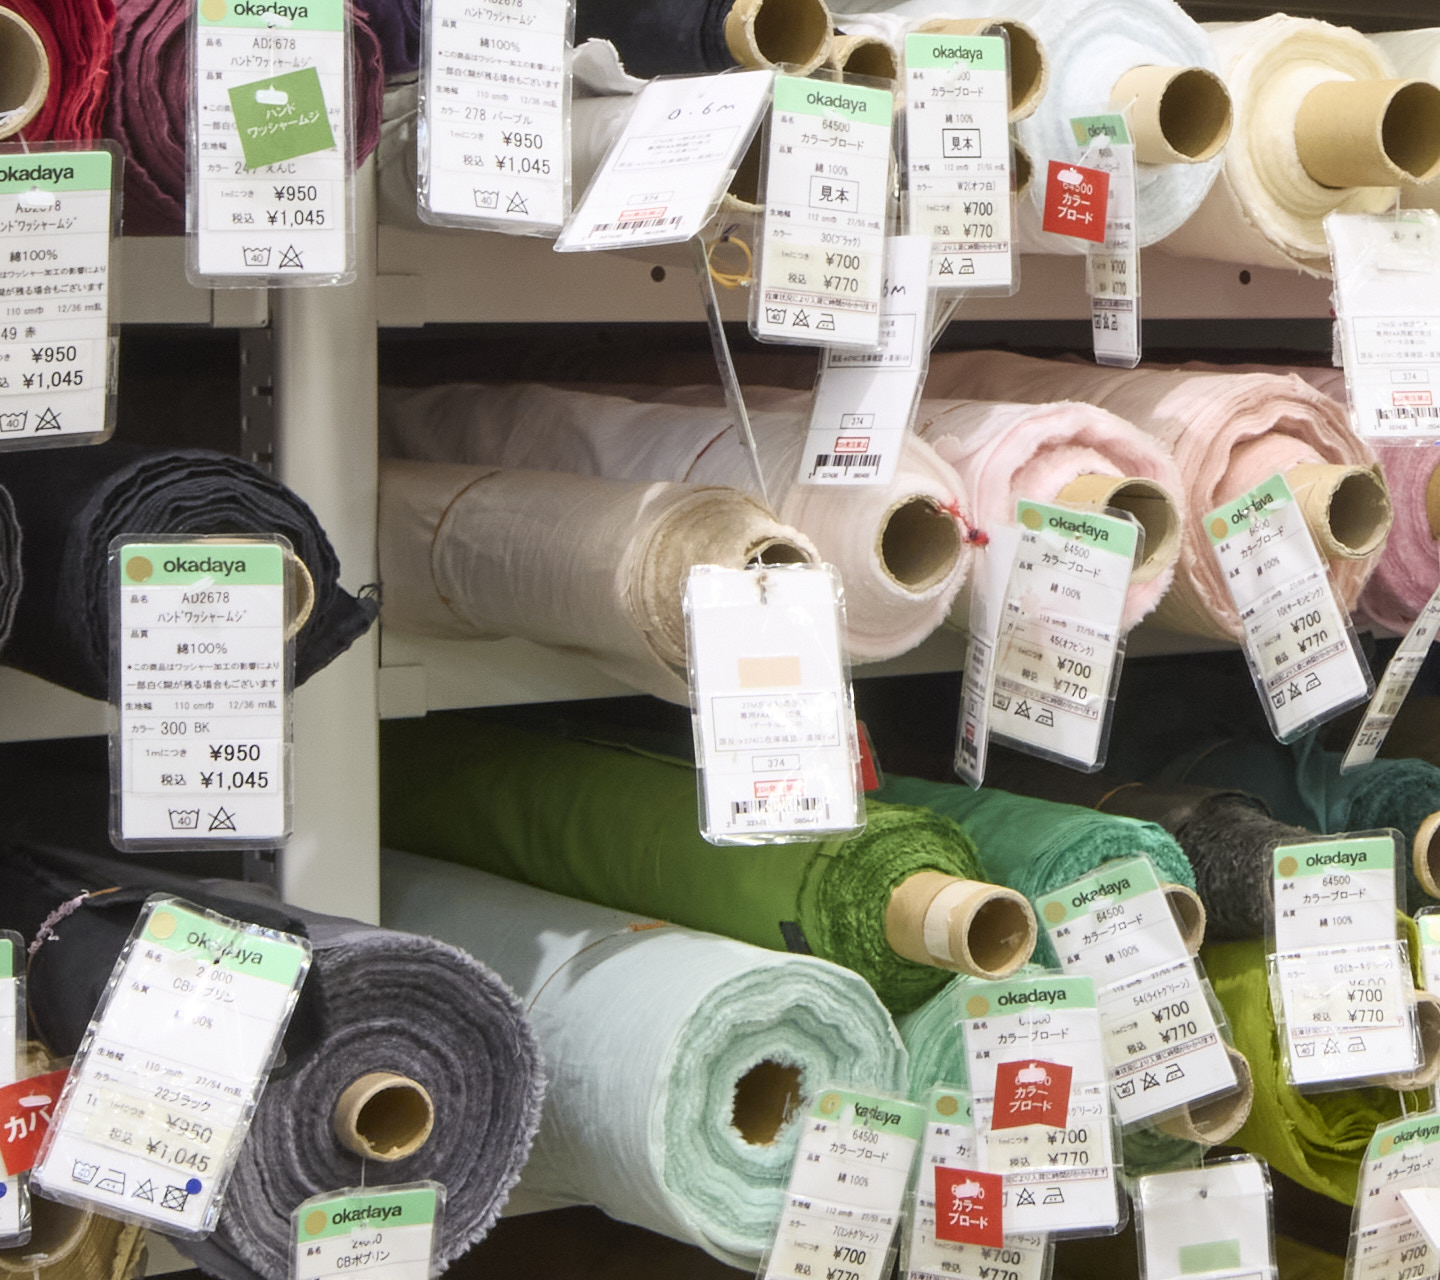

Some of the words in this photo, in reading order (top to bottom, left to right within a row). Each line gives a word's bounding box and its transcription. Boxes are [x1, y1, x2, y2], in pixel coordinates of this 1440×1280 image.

[807, 92, 866, 114] okadaya
[495, 155, 550, 174] ¥1,045
[819, 185, 848, 203] 見本
[1057, 203, 1094, 222] ブロード
[10, 250, 58, 262] 綿100%
[826, 252, 860, 270] ¥700
[824, 275, 858, 292] ¥770
[23, 370, 83, 389] ¥1,045
[163, 557, 246, 577] okadaya
[209, 745, 260, 761] ¥950
[200, 772, 268, 790] ¥1,045
[1348, 989, 1382, 1002] ¥700
[1347, 1009, 1383, 1022] ¥770
